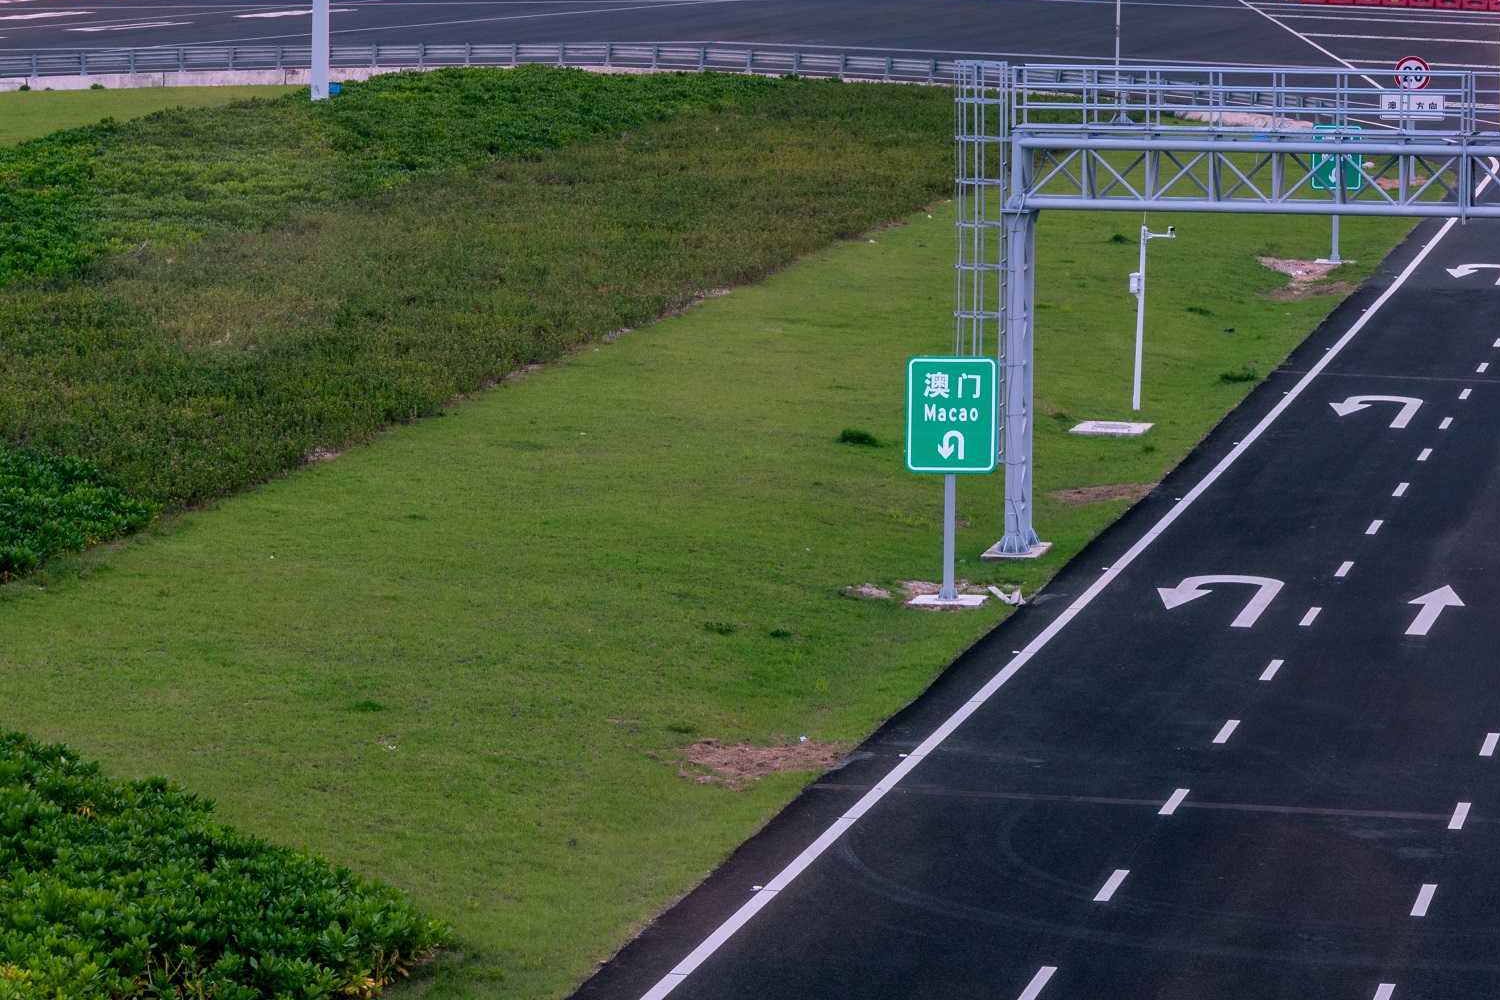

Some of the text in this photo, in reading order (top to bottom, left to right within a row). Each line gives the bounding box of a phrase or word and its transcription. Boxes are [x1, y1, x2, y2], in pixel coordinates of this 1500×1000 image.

[1403, 66, 1423, 82] 20
[1387, 101, 1438, 110] 澳方向
[924, 372, 981, 399] 澳门
[924, 404, 979, 422] Macao
